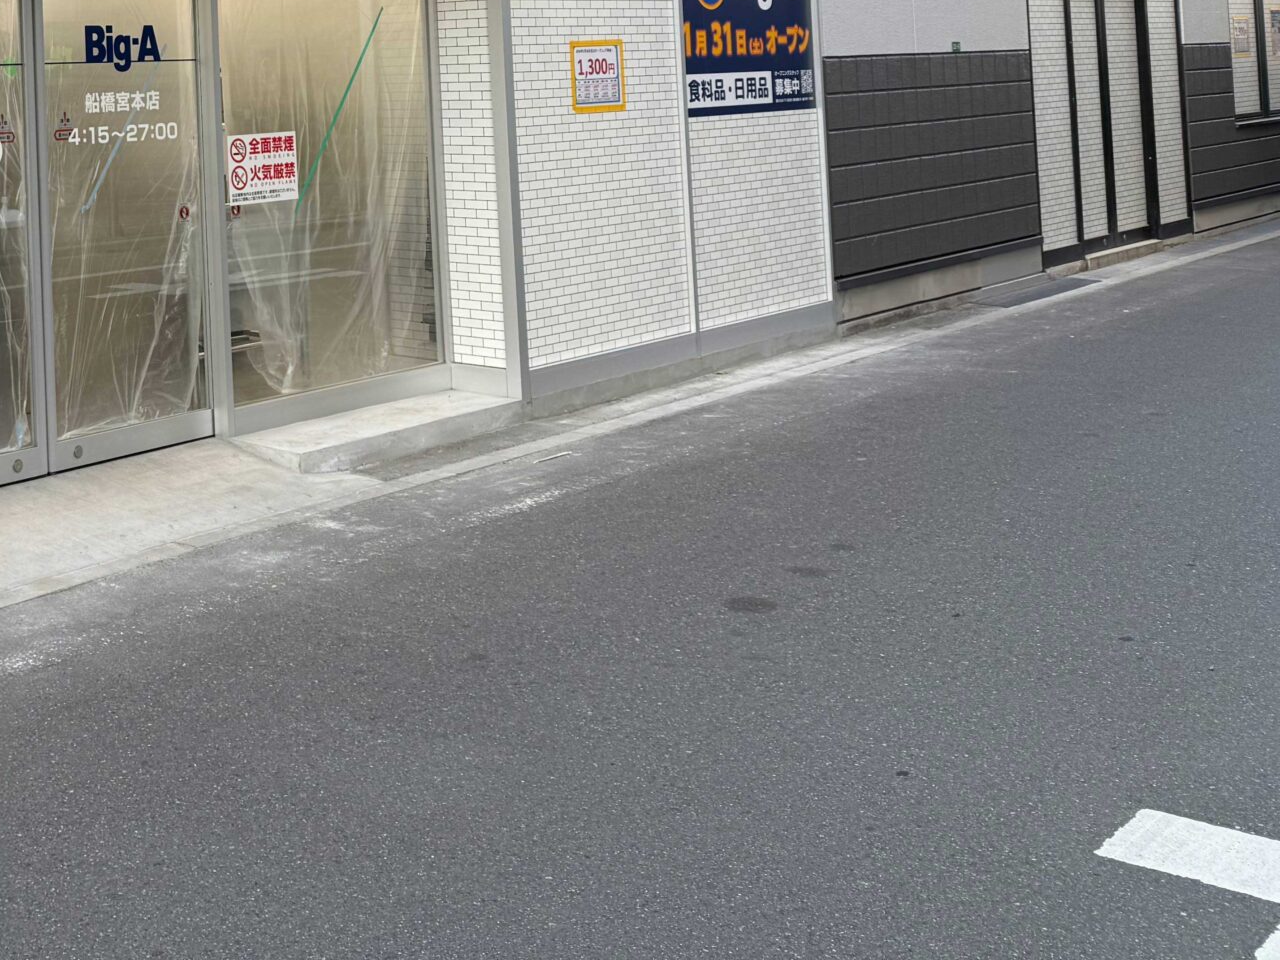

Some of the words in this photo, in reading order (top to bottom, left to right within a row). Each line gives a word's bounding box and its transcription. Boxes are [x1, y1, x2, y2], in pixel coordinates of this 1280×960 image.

[84, 25, 161, 72] Big-A
[578, 58, 615, 78] 1,300円
[688, 76, 769, 103] 食料品・日用品
[774, 78, 800, 96] 募集中
[85, 91, 160, 113] 船橋宮本店
[249, 136, 295, 155] 全面禁煙
[250, 162, 296, 182] 火気厳禁
